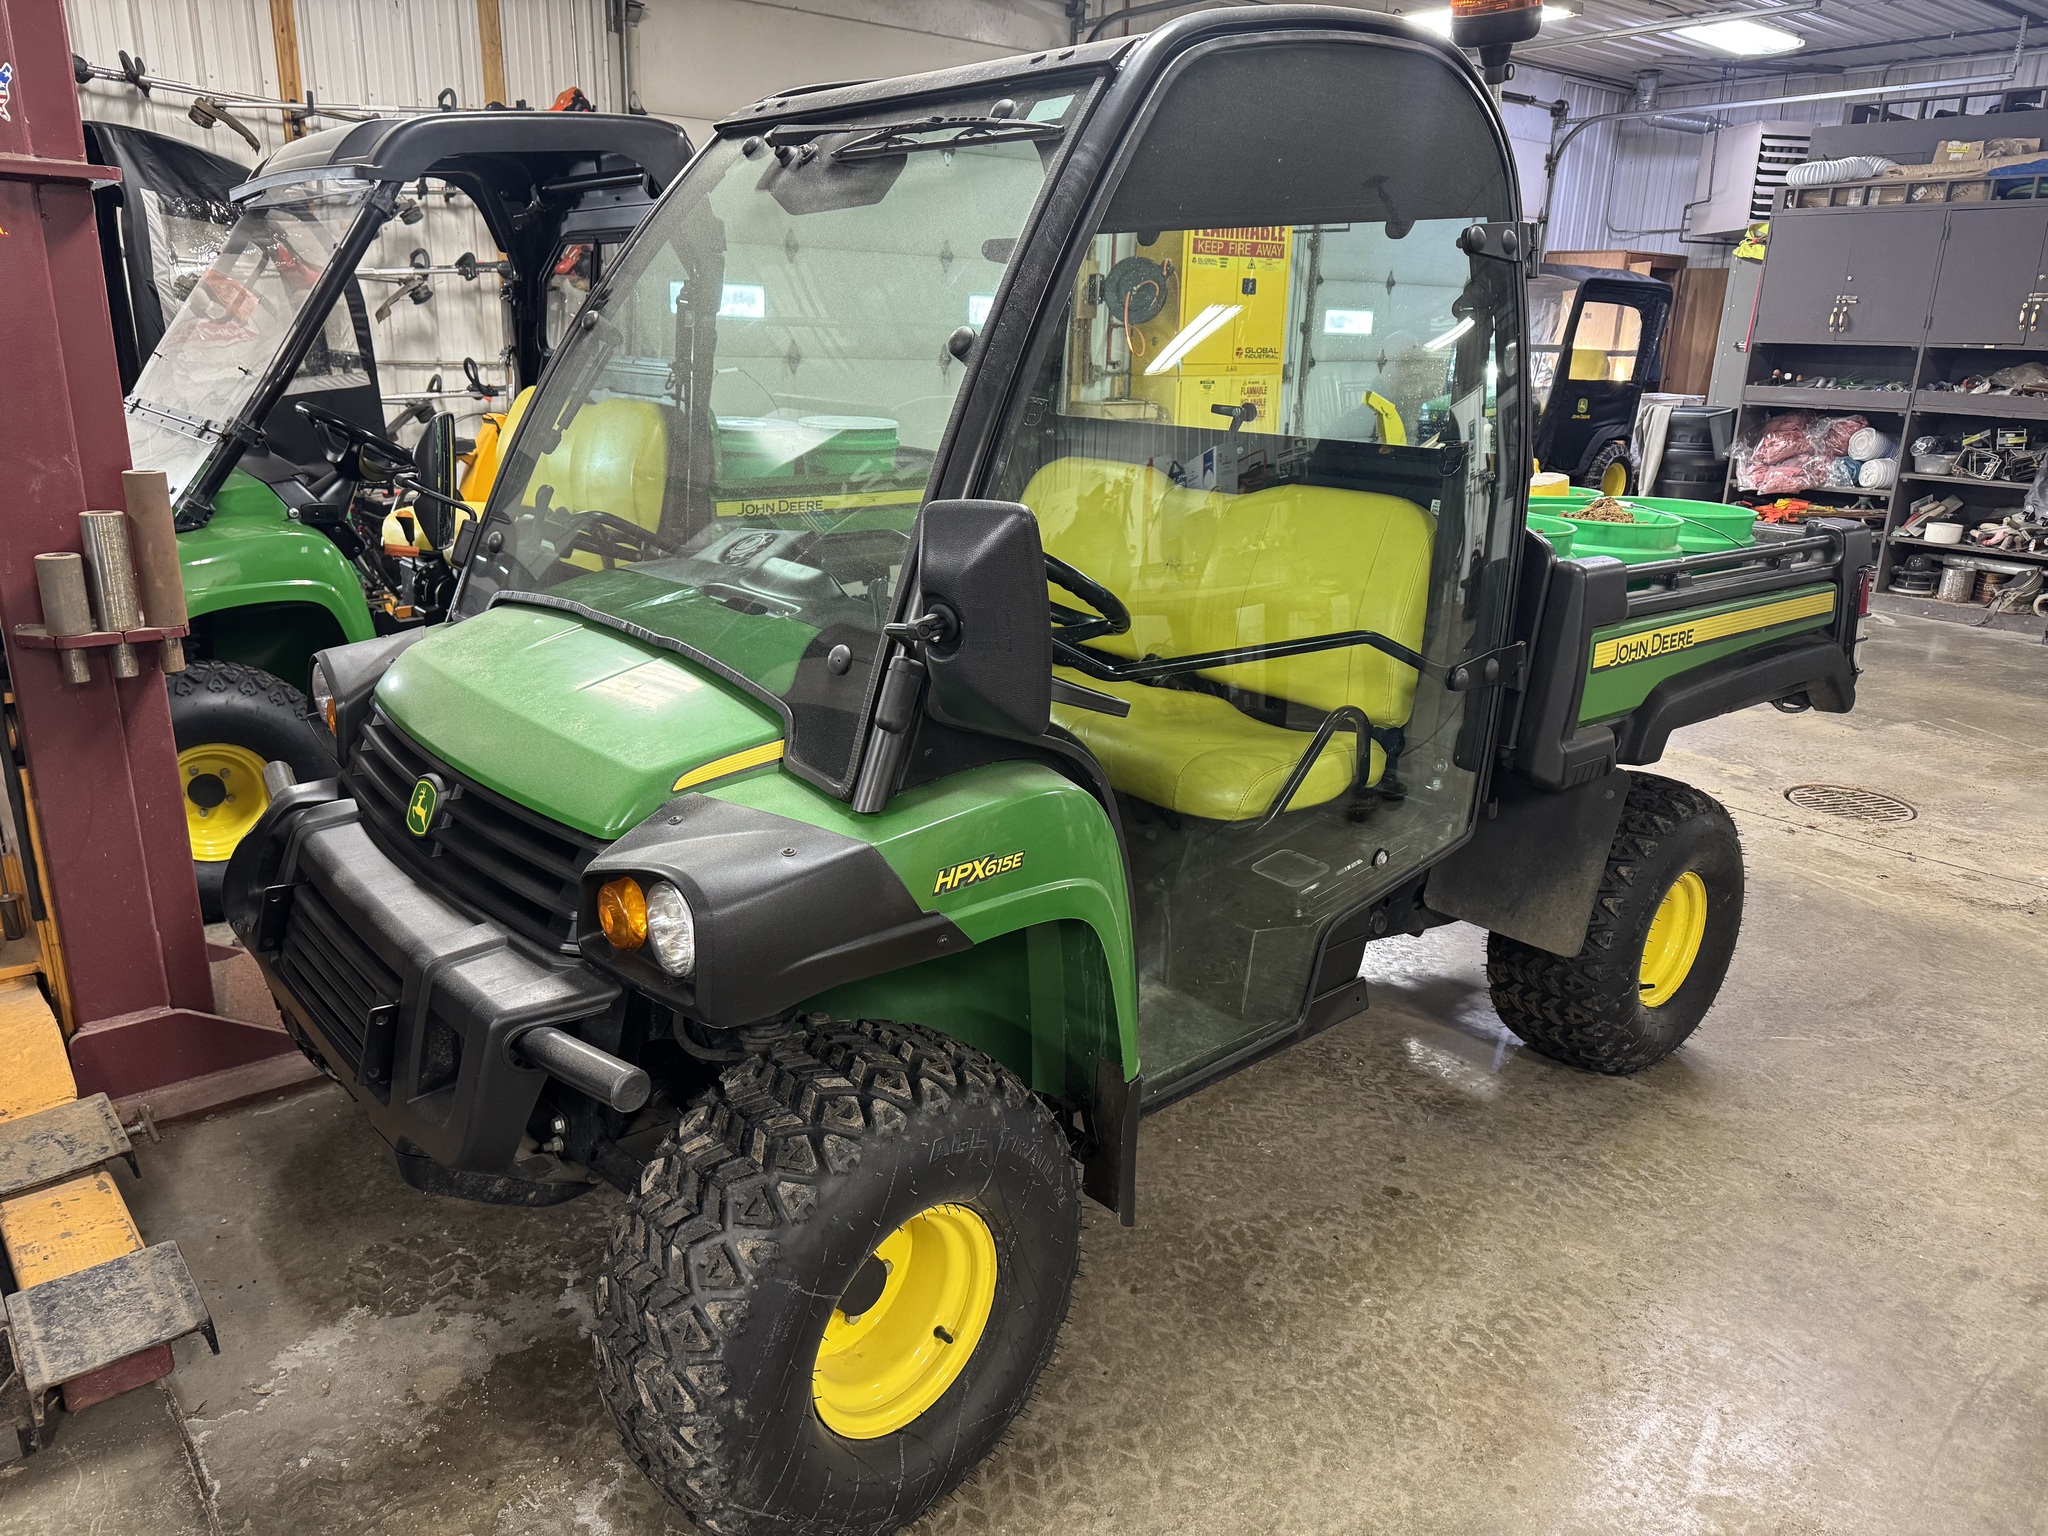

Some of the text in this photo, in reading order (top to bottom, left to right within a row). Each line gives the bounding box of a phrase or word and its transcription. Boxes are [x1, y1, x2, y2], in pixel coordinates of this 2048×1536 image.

[1197, 240, 1284, 257] KEEP FIRE AWAY
[1245, 347, 1278, 355] GLOBAL
[738, 499, 823, 516] JOHN DEERE
[1610, 628, 1695, 665] JOHN DEERE
[933, 851, 1025, 895] HPX615E
[928, 1128, 987, 1165] ALL
[999, 1130, 1057, 1185] TRAIL
